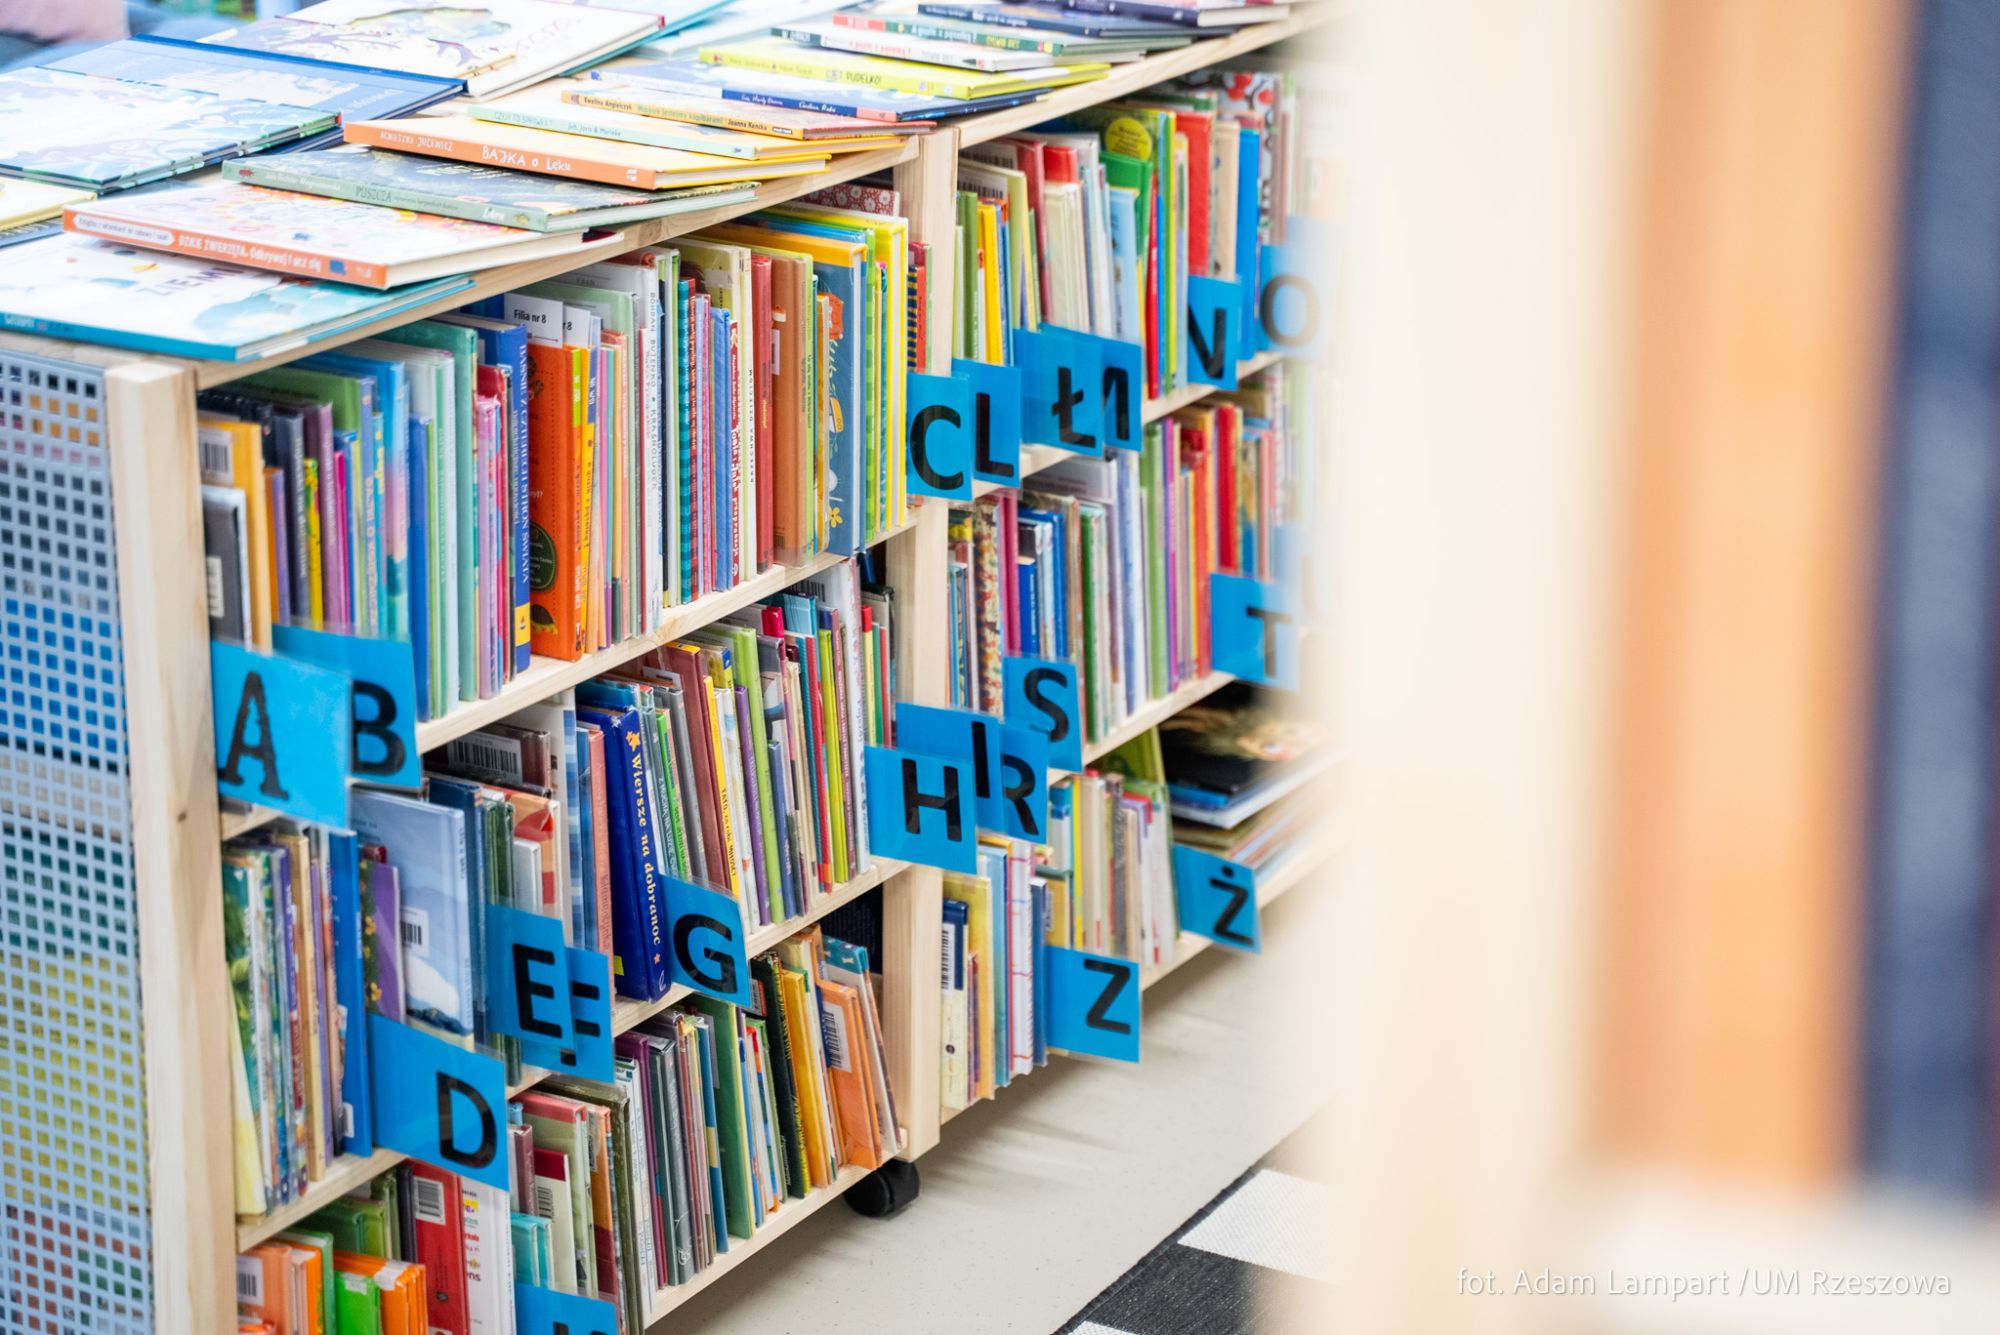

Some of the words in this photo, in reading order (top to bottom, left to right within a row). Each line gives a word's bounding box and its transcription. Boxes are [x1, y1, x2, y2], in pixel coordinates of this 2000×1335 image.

[482, 144, 525, 167] BAJKA
[514, 308, 531, 322] Filia
[531, 313, 540, 323] nr
[541, 314, 547, 324] 8
[648, 292, 656, 331] BOHDAN
[1263, 274, 1320, 348] O
[518, 343, 528, 394] BAŚNIE
[649, 339, 657, 387] BUTENKO
[975, 392, 1014, 477] L
[1051, 366, 1097, 448] Ł
[910, 404, 964, 490] C
[520, 484, 529, 528] STRON
[521, 531, 530, 583] ŚWIATA
[1246, 606, 1292, 678] T
[217, 670, 290, 801] A
[352, 680, 407, 777] B
[1023, 667, 1069, 743] S
[631, 752, 647, 827] Wiersze
[901, 758, 963, 842] H
[641, 834, 651, 857] na
[644, 862, 662, 945] dobranoc
[1209, 866, 1254, 945] Ż
[512, 943, 563, 1039] E
[673, 913, 738, 994] G
[1084, 958, 1131, 1035] Z
[436, 1071, 497, 1170] D
